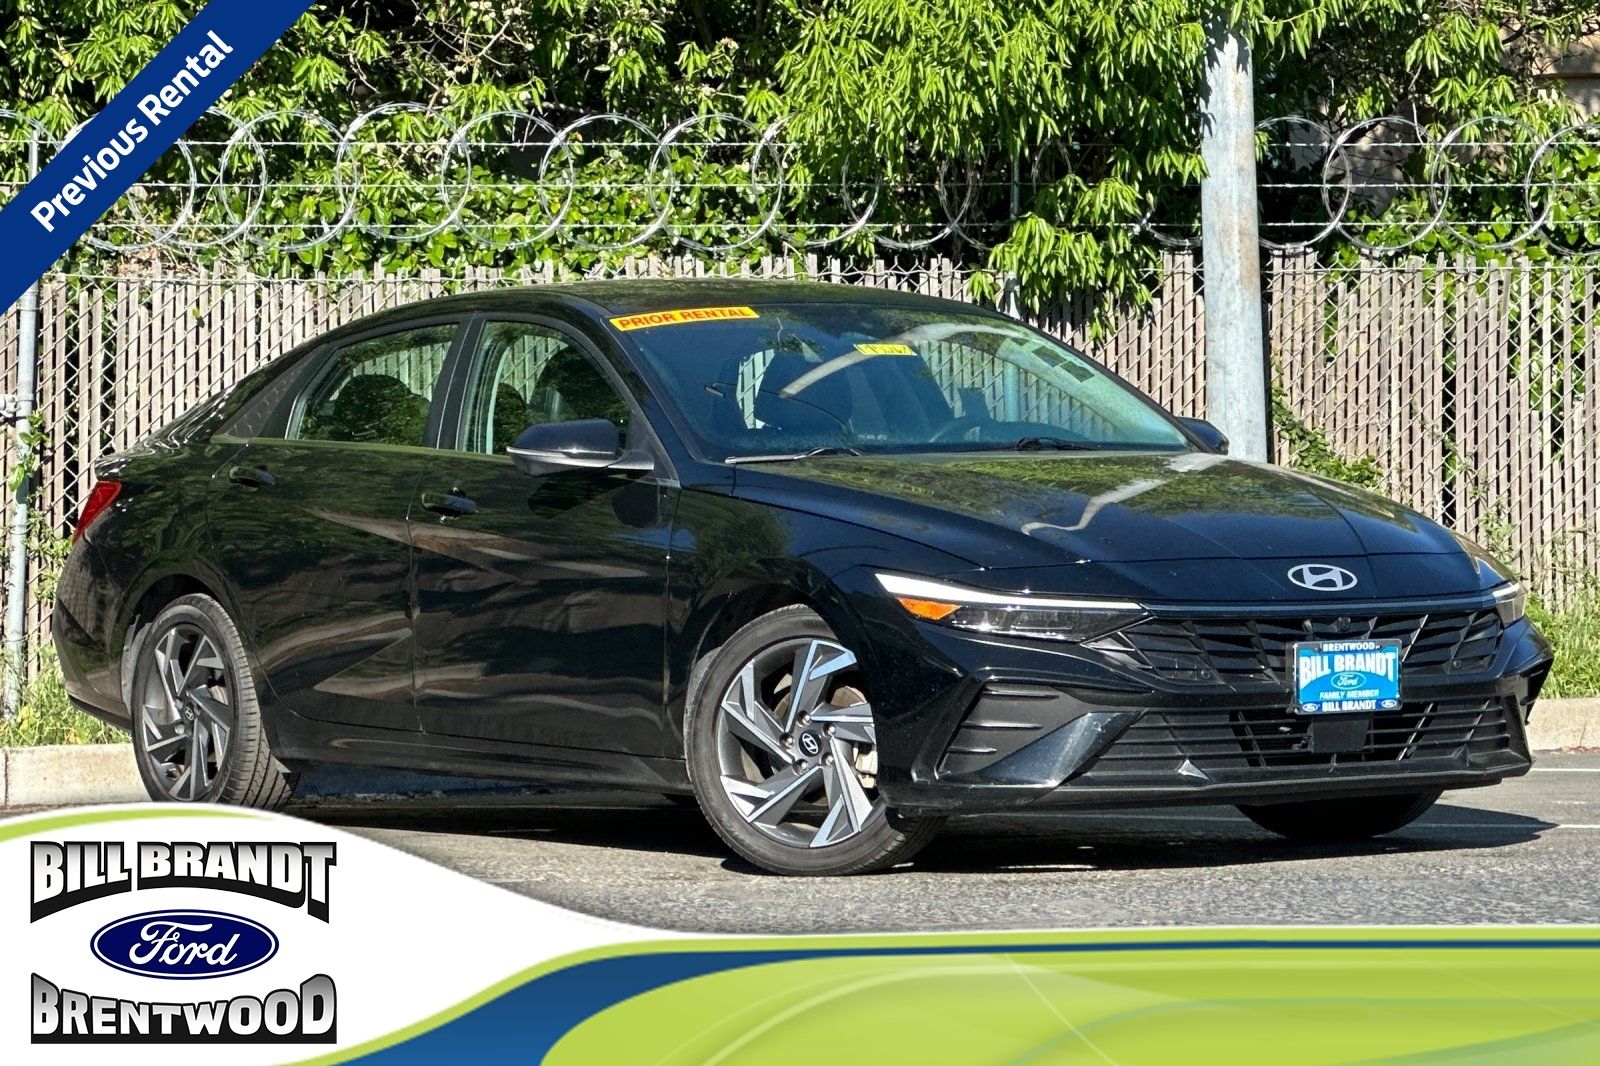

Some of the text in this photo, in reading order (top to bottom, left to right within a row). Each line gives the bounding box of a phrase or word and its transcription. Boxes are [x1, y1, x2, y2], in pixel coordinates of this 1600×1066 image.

[619, 308, 751, 329] PRIOR RENTAL
[1322, 642, 1375, 652] BRENTWOOD
[1300, 652, 1396, 689] BILL BRANDT
[1337, 674, 1359, 686] Ford
[1320, 689, 1379, 700] FAMILY MEMBER
[1322, 701, 1341, 712] BILL
[1342, 700, 1377, 711] BRANDT
